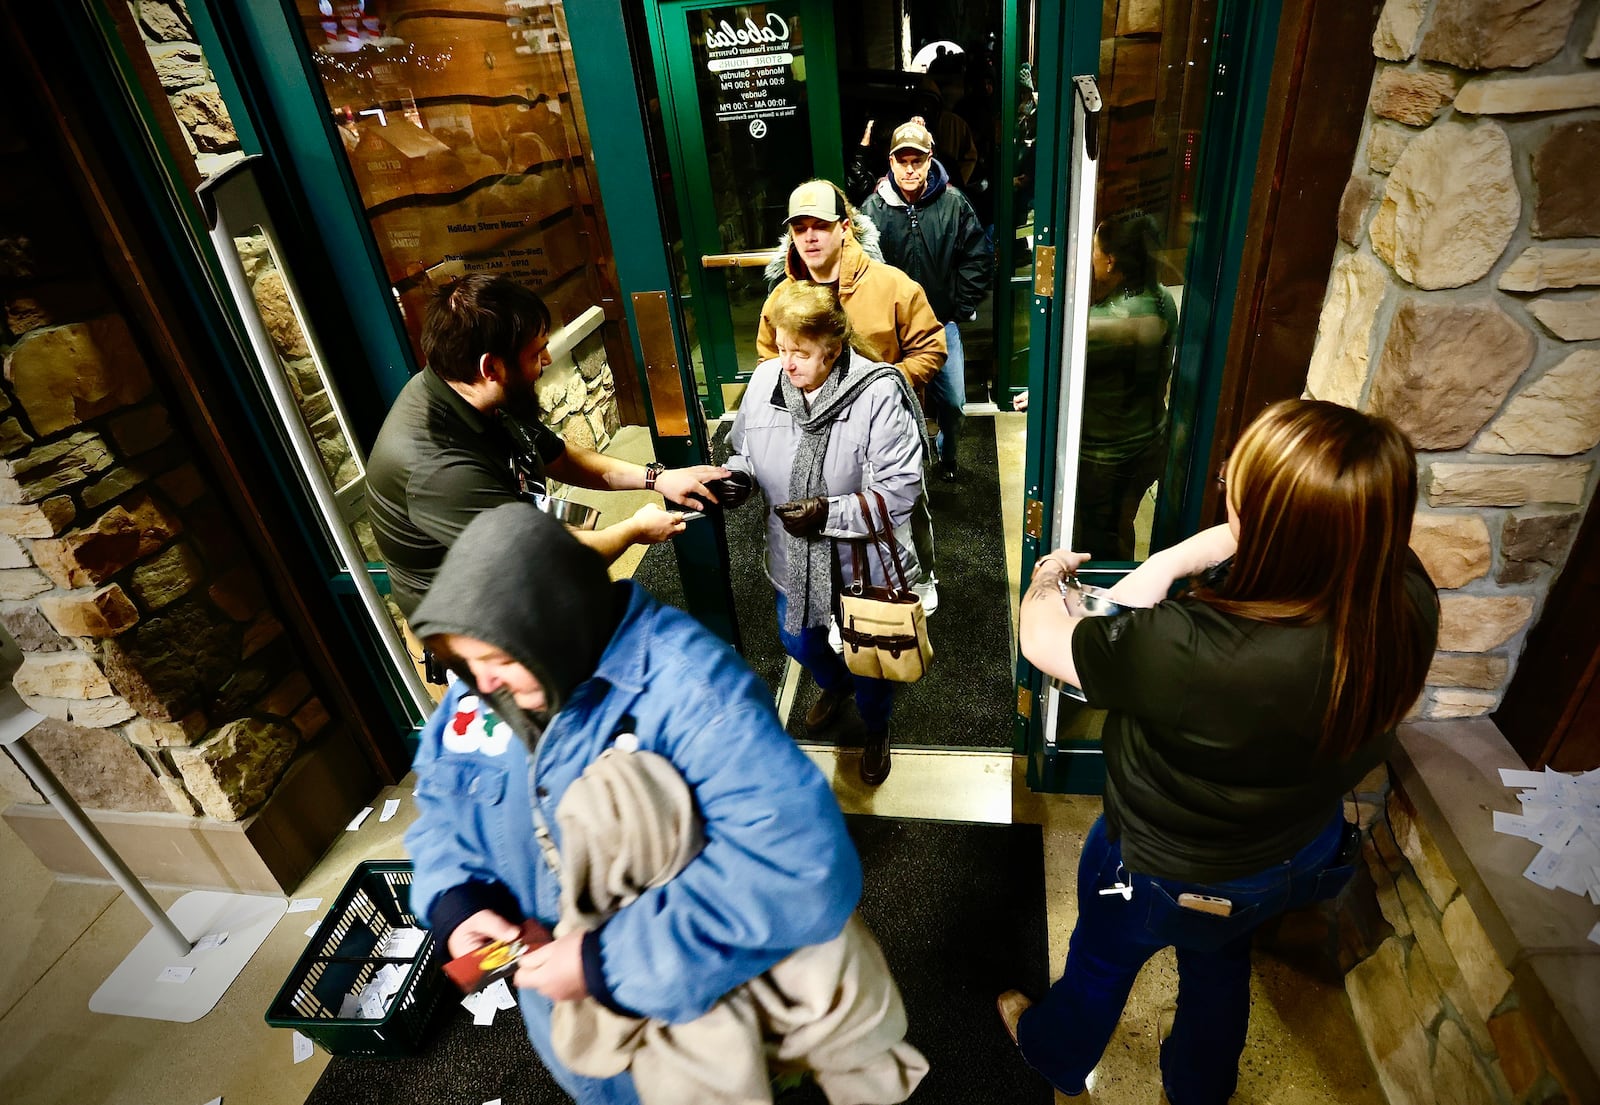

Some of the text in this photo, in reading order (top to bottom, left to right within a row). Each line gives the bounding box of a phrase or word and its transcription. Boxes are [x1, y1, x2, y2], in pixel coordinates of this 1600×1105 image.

[447, 220, 525, 233] Holiday Store Hours
